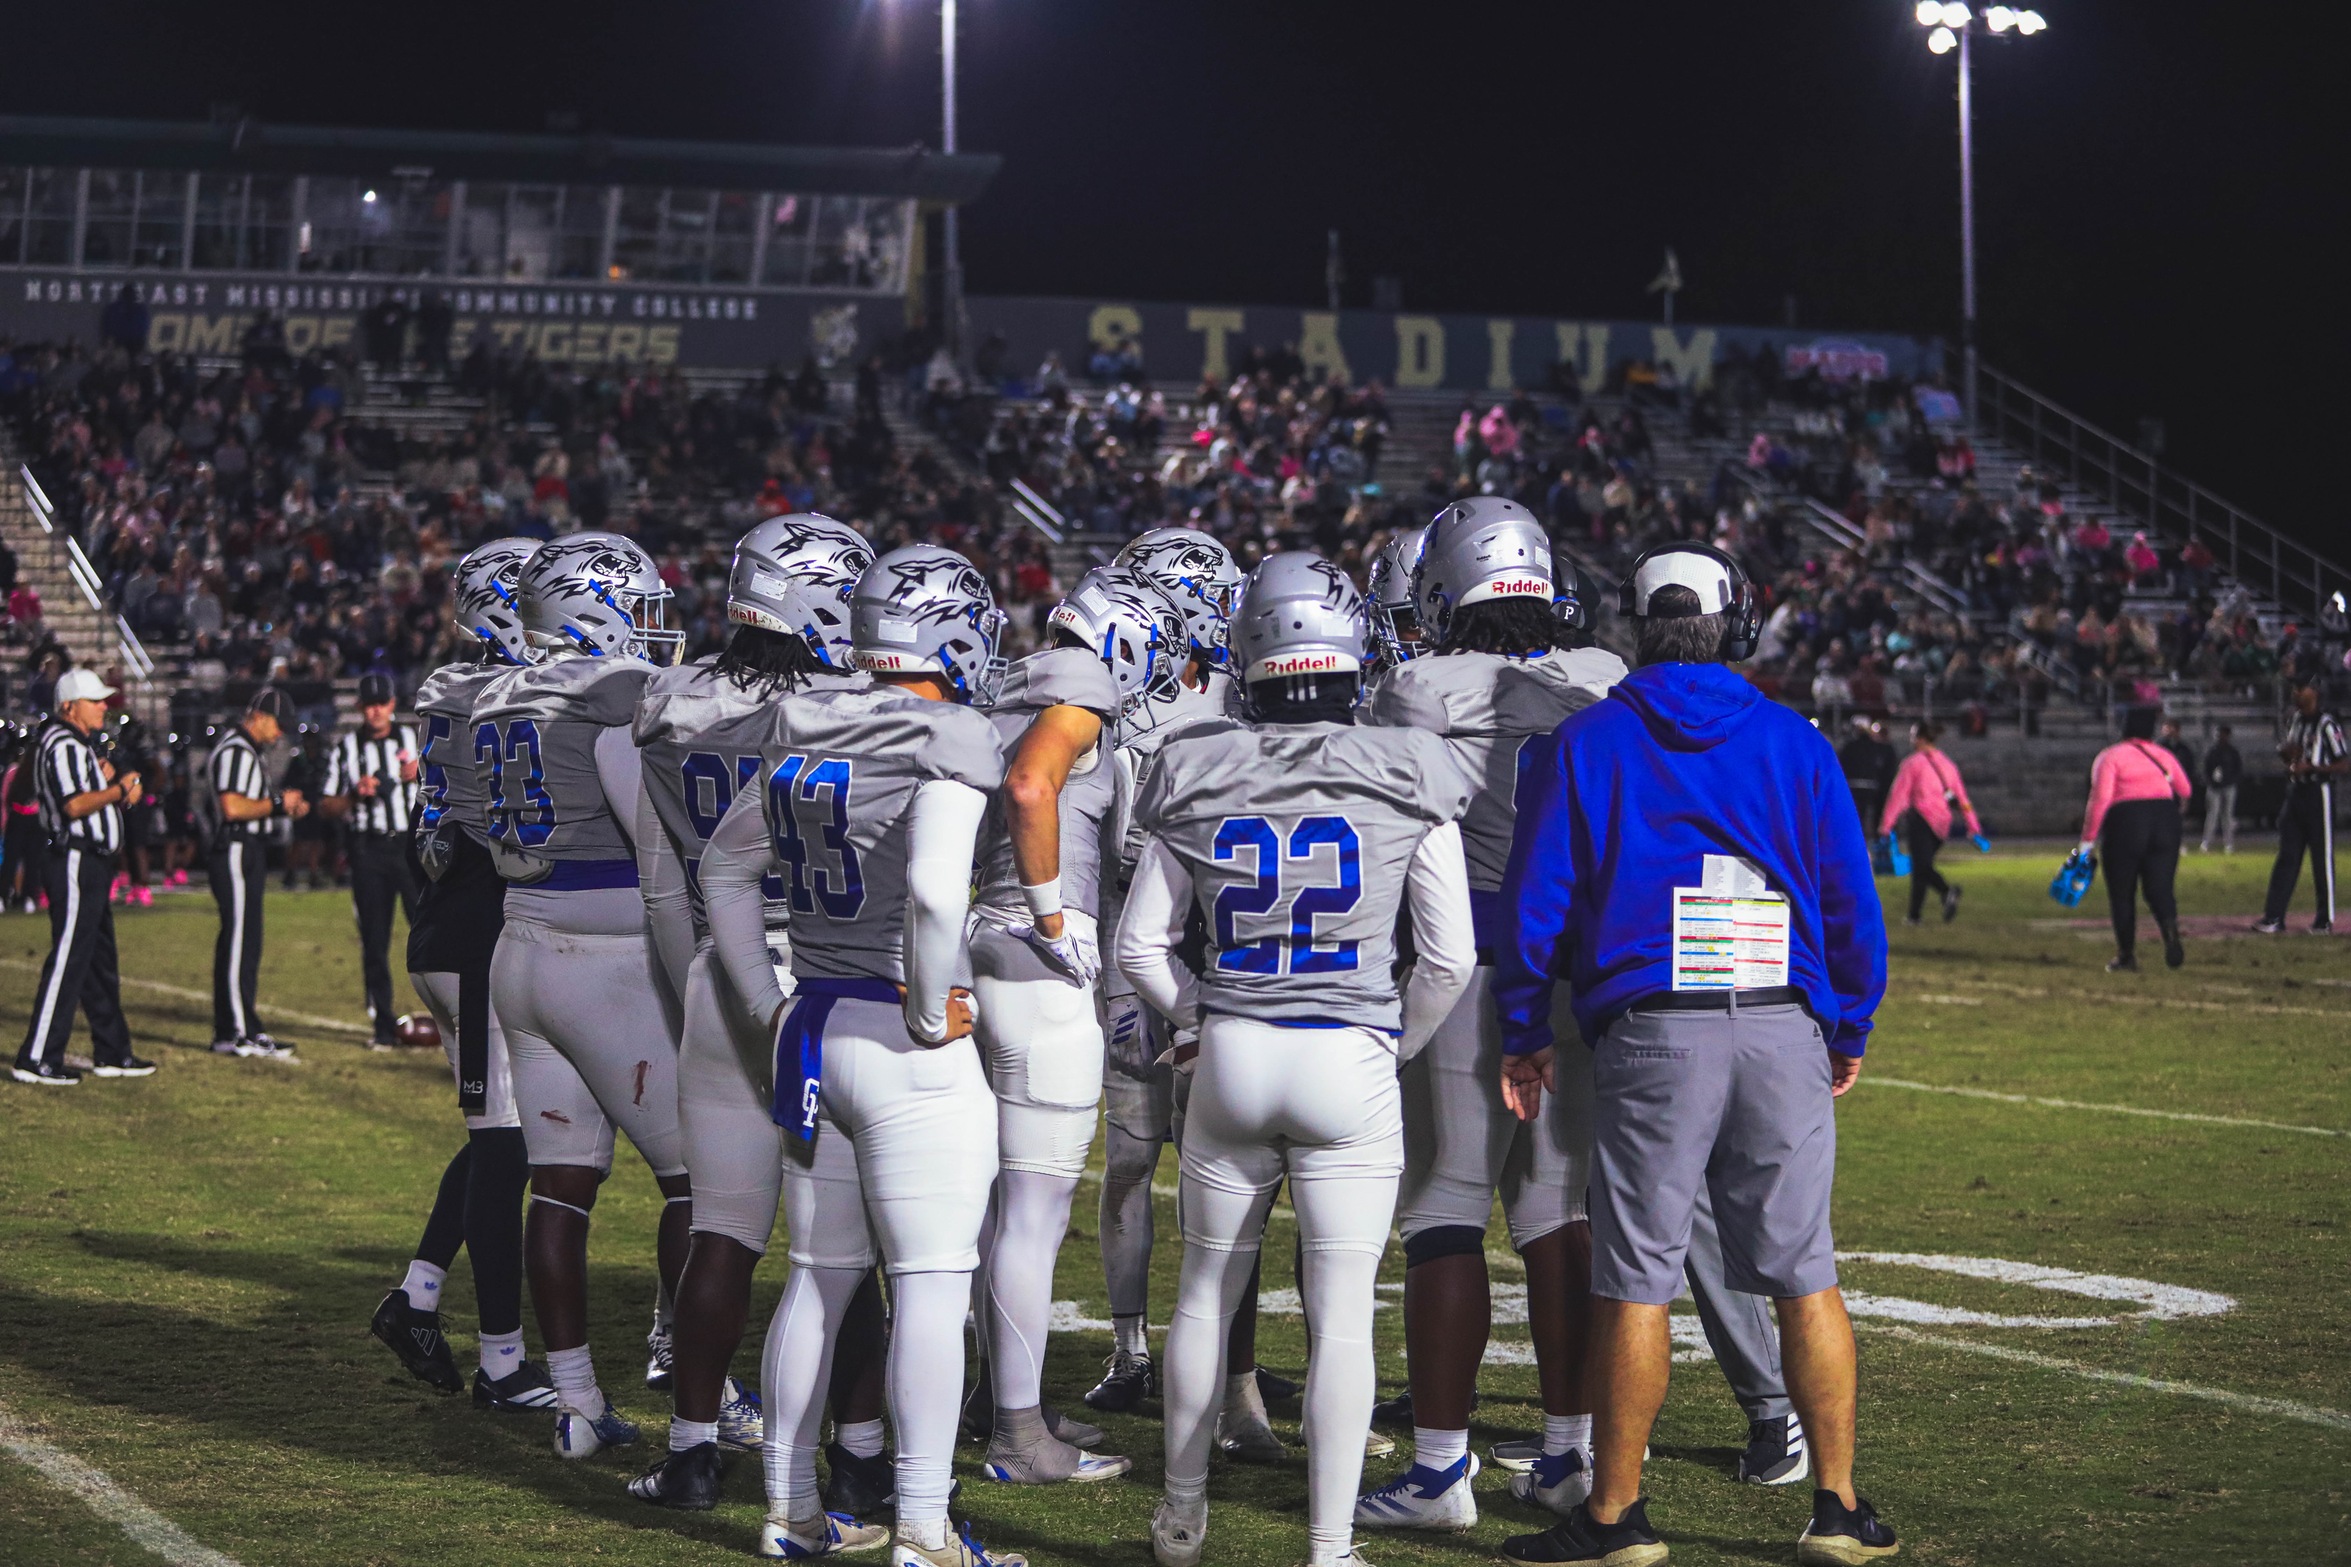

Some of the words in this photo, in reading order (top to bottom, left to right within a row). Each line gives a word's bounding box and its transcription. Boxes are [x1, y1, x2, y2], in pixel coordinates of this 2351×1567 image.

[227, 284, 421, 311] MISSISSII
[441, 289, 617, 315] OMMUNITY
[632, 294, 758, 321] COLLEGE
[149, 313, 254, 354] OME
[284, 316, 357, 357] OF
[490, 319, 682, 363] TIGERS
[1088, 305, 1718, 392] STADIUM
[1491, 579, 1549, 595] Riddell
[1264, 655, 1336, 675] Riddell
[474, 719, 560, 848] 33
[767, 754, 868, 920] 43
[1211, 814, 1364, 976] 22
